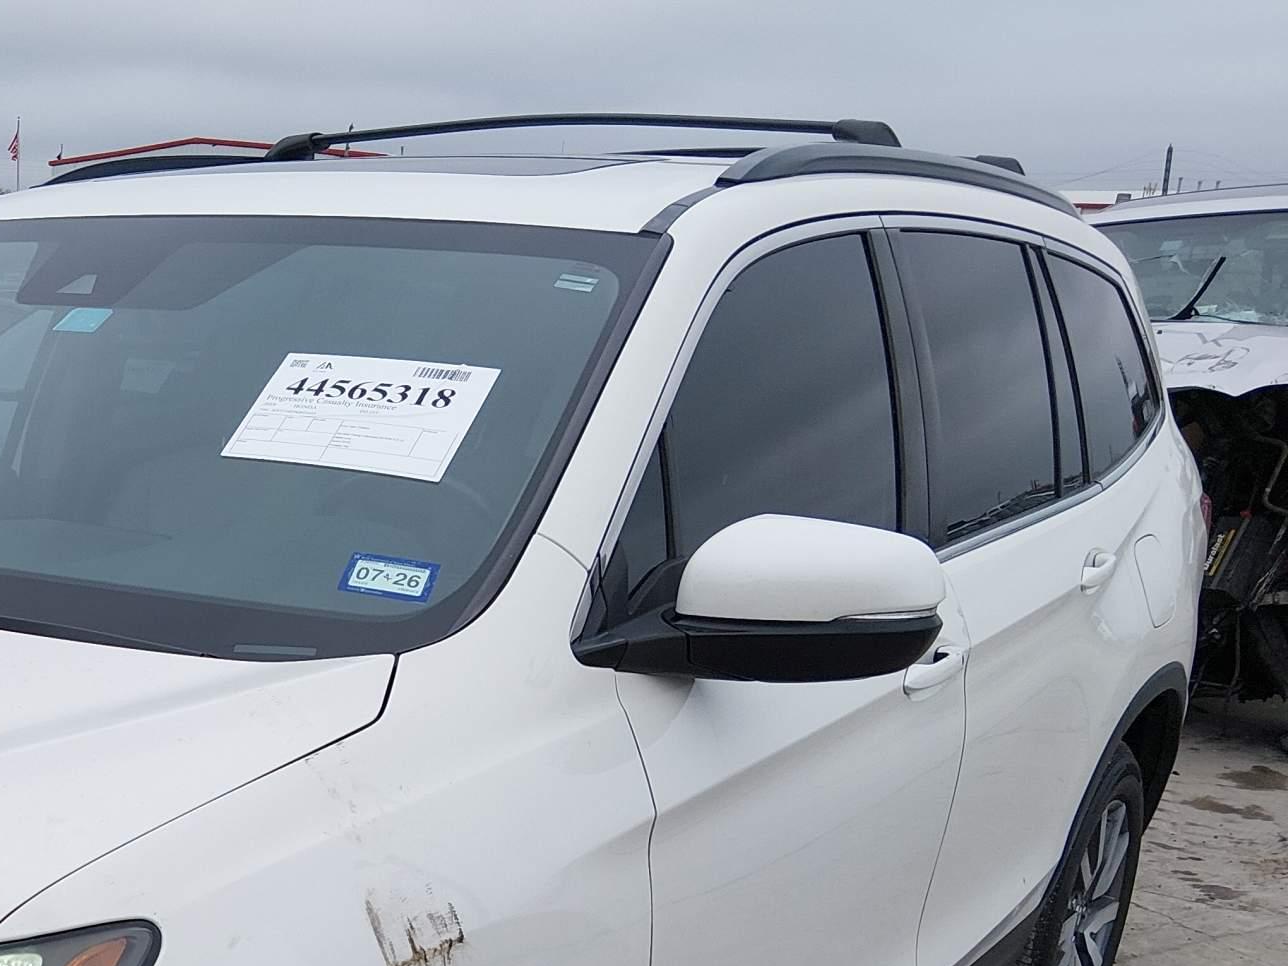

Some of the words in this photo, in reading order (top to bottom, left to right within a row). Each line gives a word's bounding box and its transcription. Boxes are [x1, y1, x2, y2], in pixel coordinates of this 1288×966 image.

[267, 394, 315, 405] Progressive
[316, 397, 351, 407] Casualty
[355, 400, 397, 411] Insurance
[286, 376, 456, 408] 44565318
[356, 567, 384, 581] 07
[392, 572, 422, 588] 26
